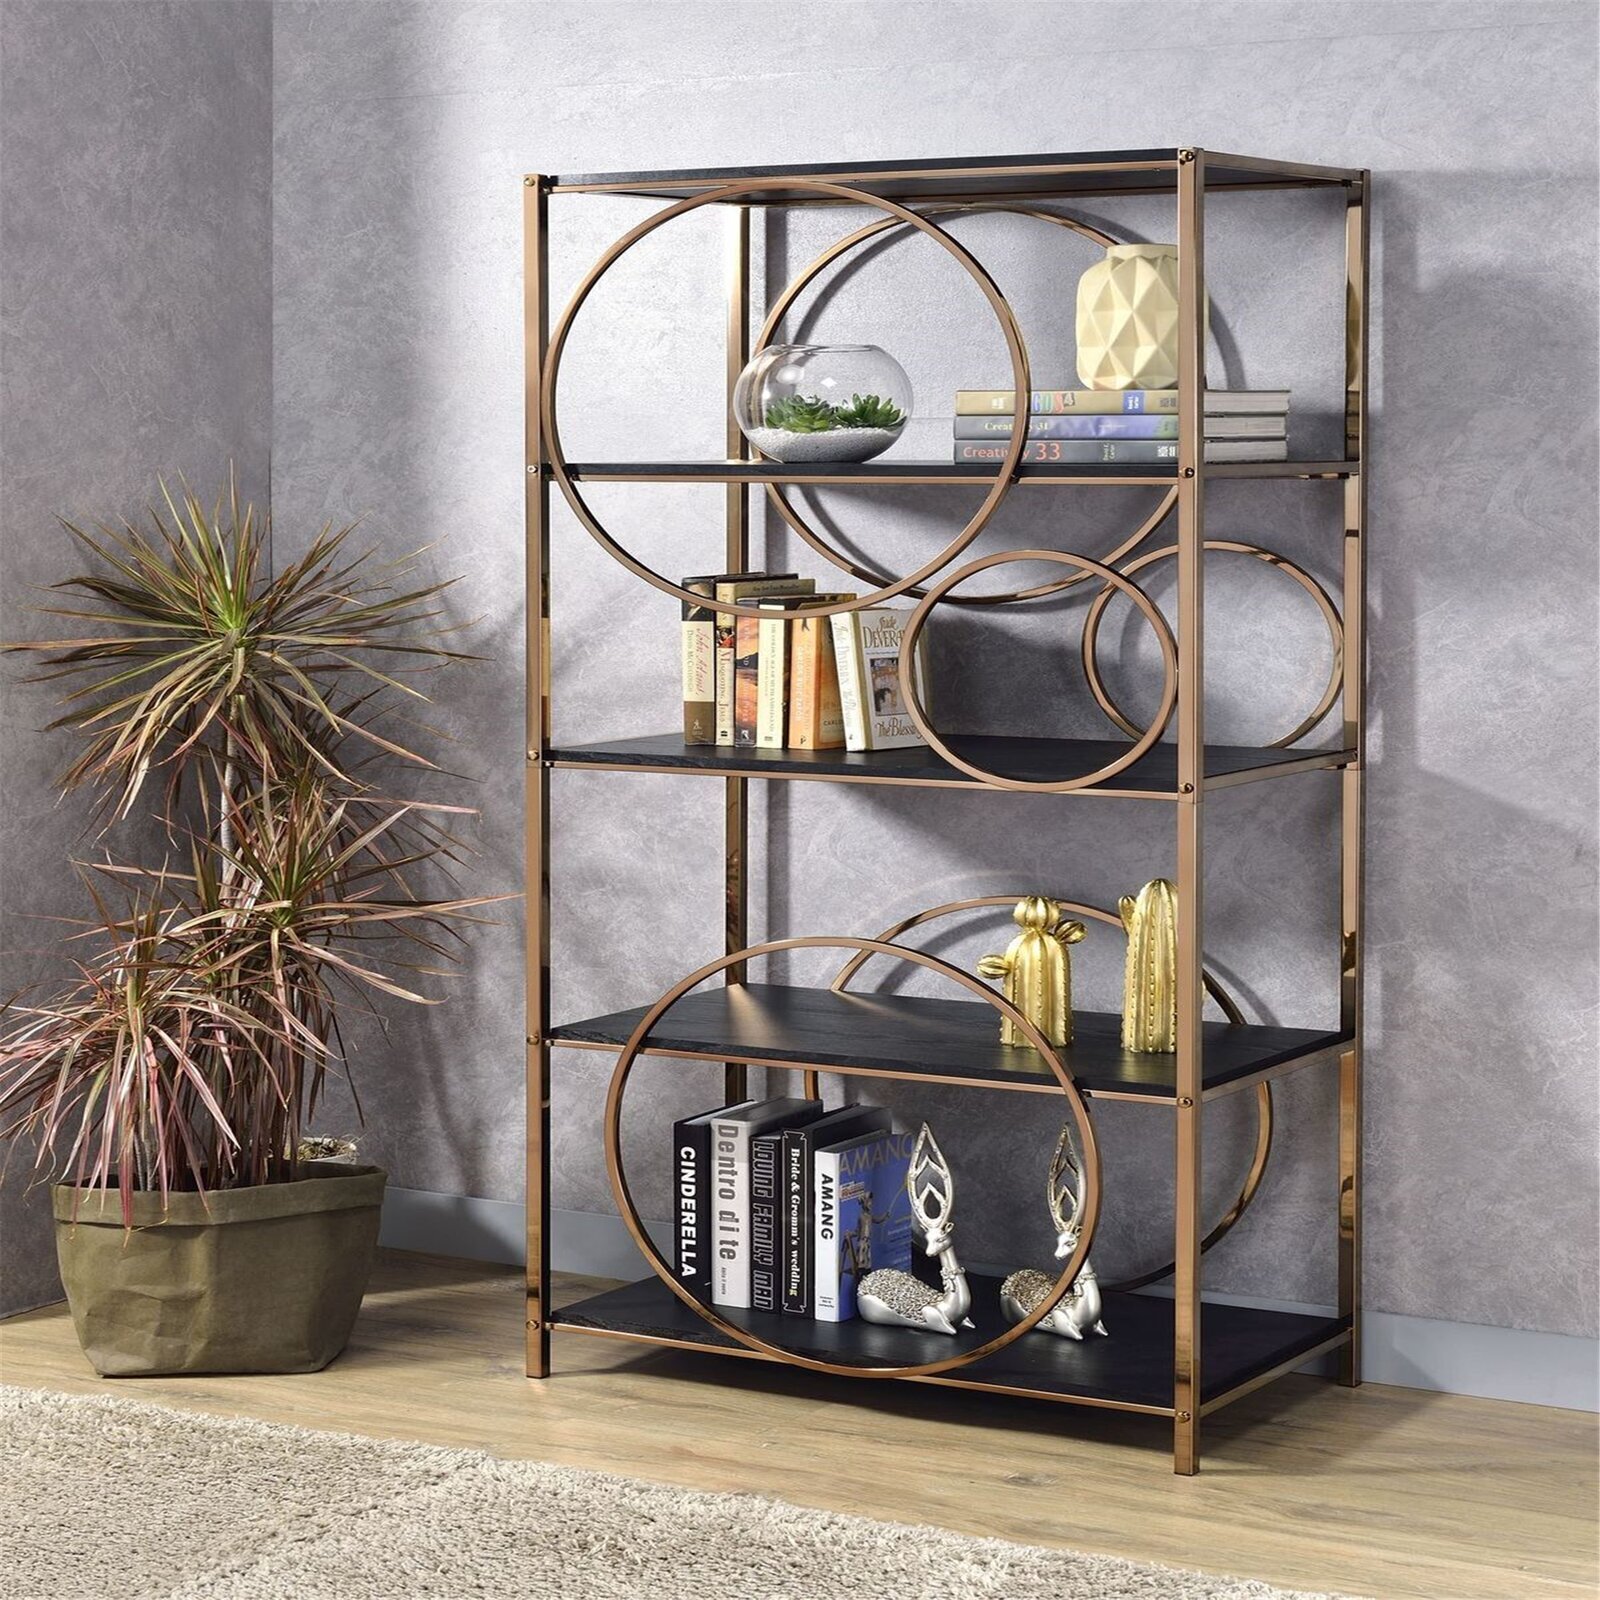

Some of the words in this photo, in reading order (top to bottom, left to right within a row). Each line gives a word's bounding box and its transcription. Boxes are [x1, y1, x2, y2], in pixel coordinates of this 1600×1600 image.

[963, 446, 1030, 459] Creativy
[1035, 442, 1062, 460] 33
[863, 626, 905, 648] DEVERA
[718, 1124, 739, 1200] Dentro
[791, 1148, 800, 1180] Bride
[791, 1182, 800, 1193] &
[680, 1146, 697, 1277] CINDERELLA
[719, 1210, 740, 1233] di
[821, 1173, 834, 1240] AMANG
[719, 1239, 739, 1260] te
[752, 1203, 774, 1266] FAMILY
[753, 1269, 774, 1310] MAN
[789, 1250, 800, 1296] wedding
